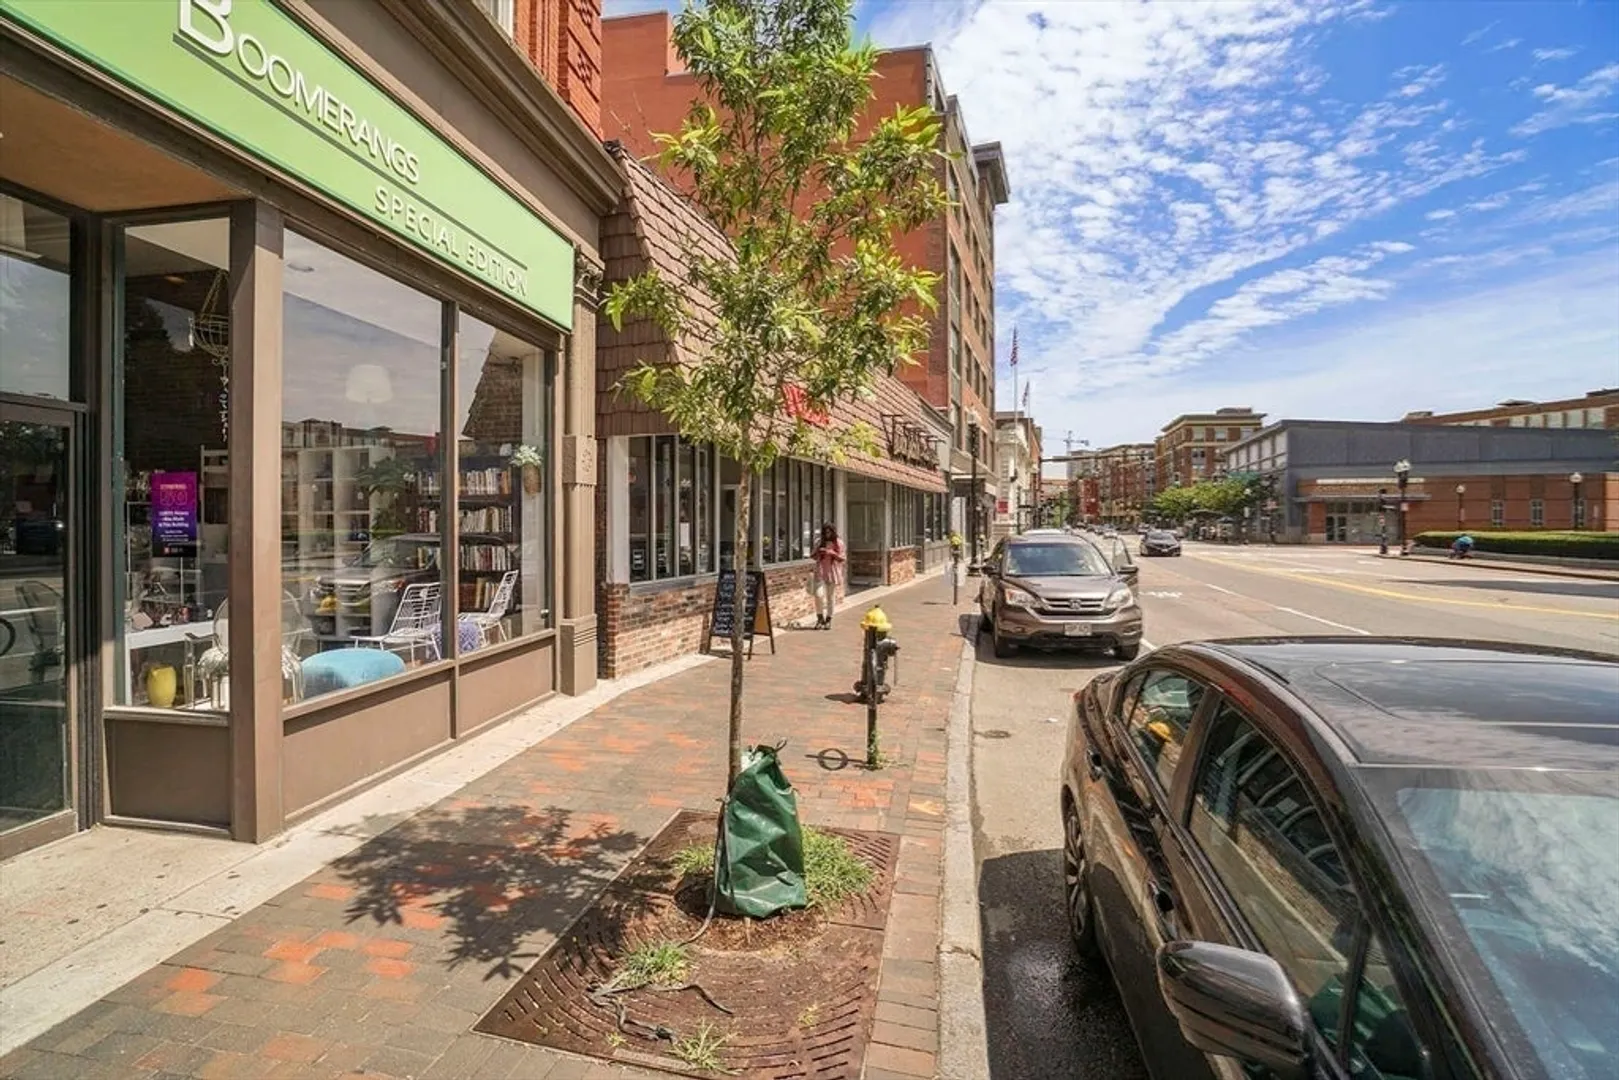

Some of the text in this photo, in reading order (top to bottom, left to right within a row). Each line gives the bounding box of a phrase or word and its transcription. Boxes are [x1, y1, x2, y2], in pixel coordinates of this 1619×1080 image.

[179, 0, 419, 184] BOOMERANGS
[375, 186, 527, 296] SPECIAL EDITION
